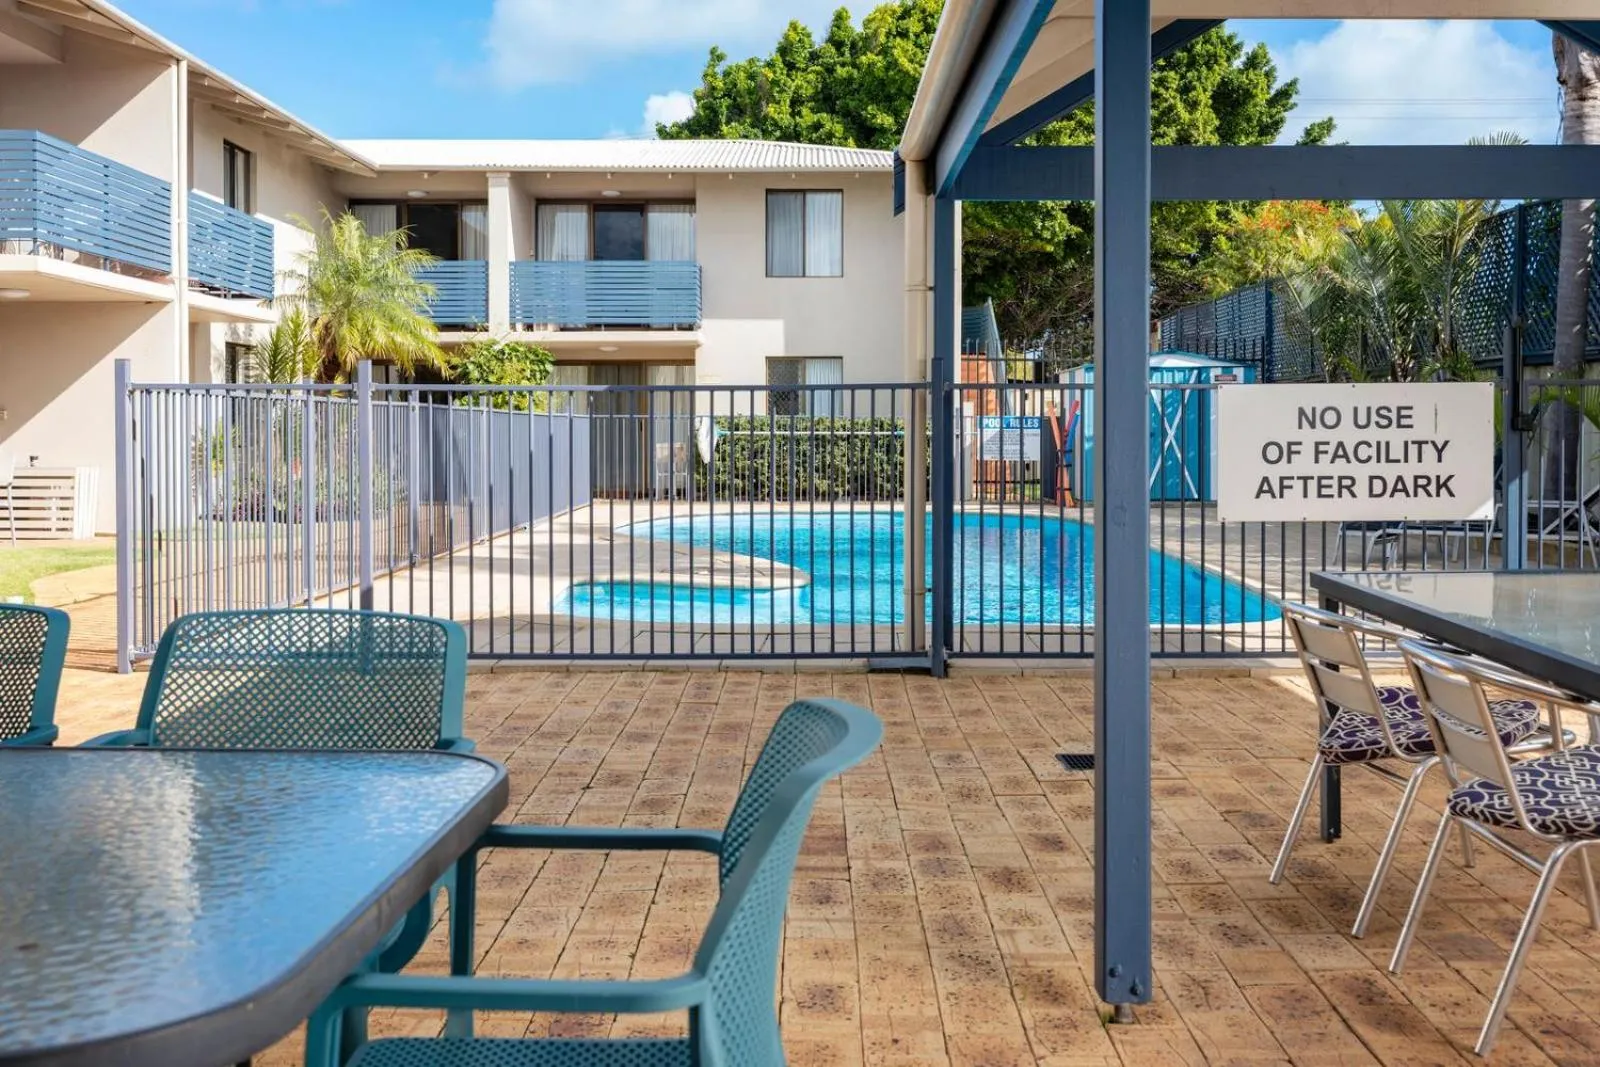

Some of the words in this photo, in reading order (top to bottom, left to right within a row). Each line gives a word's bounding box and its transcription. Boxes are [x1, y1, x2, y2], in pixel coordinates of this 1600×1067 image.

[1297, 406, 1342, 430] NO
[1352, 405, 1414, 430] USE
[1261, 440, 1303, 465] OF
[1313, 439, 1451, 465] FACILITY
[1254, 475, 1358, 500] AFTER
[1368, 474, 1456, 499] DARK
